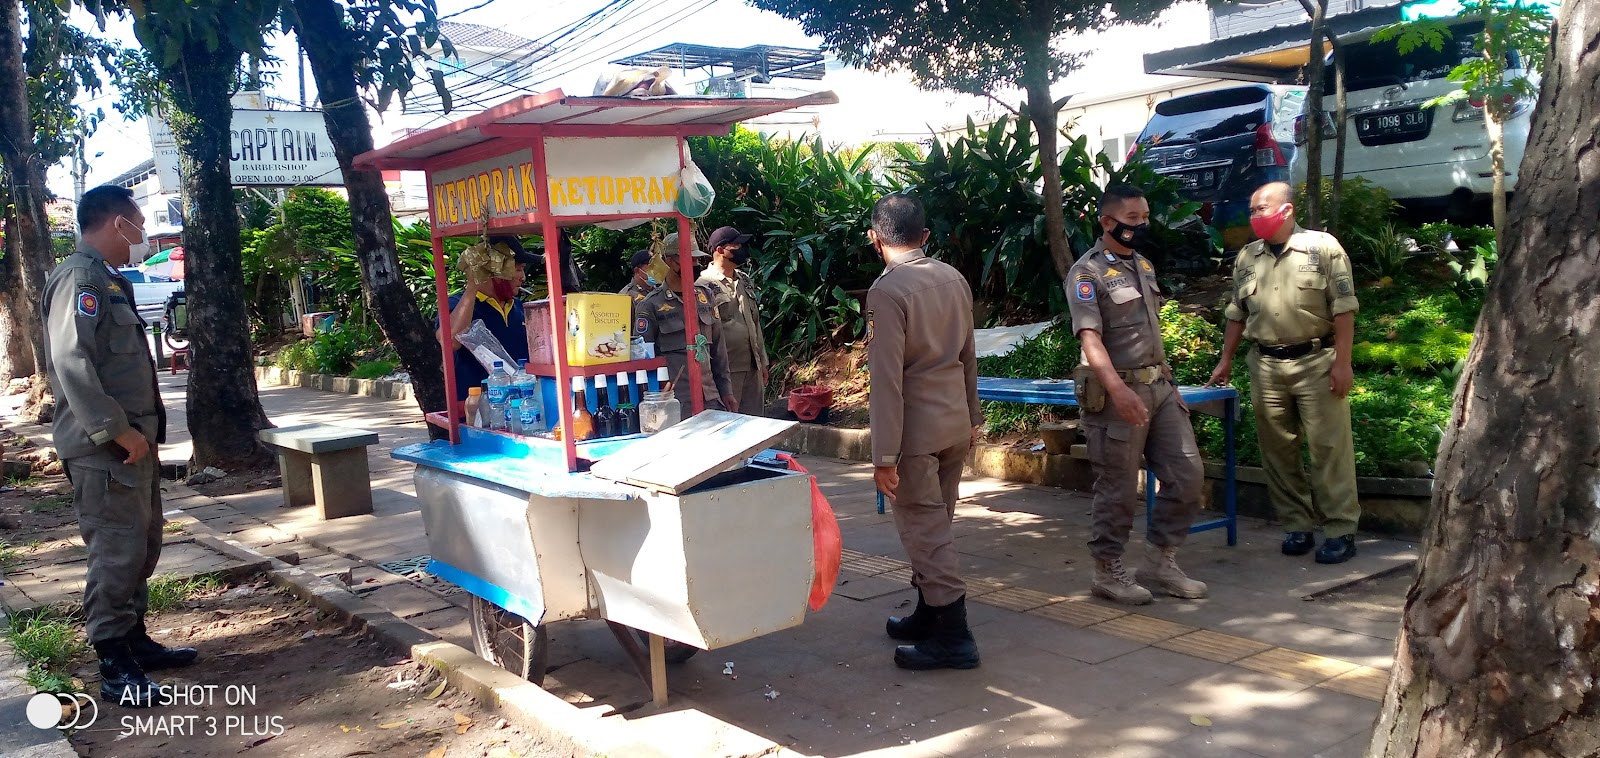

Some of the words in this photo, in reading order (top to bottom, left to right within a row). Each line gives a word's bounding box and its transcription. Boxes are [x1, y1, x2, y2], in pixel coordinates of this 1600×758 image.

[1363, 119, 1370, 131] B
[1377, 115, 1401, 128] 1099
[229, 127, 318, 161] CAPTAIN
[242, 163, 308, 171] BARBERSHOP
[234, 175, 260, 183] OPEN
[263, 175, 286, 183] 10.00
[291, 174, 314, 183] 21.00
[434, 161, 537, 227] KETOPRAK
[549, 175, 680, 208] KETOPRAK
[590, 310, 621, 319] ASSORTED
[594, 317, 621, 325] BISCUITS
